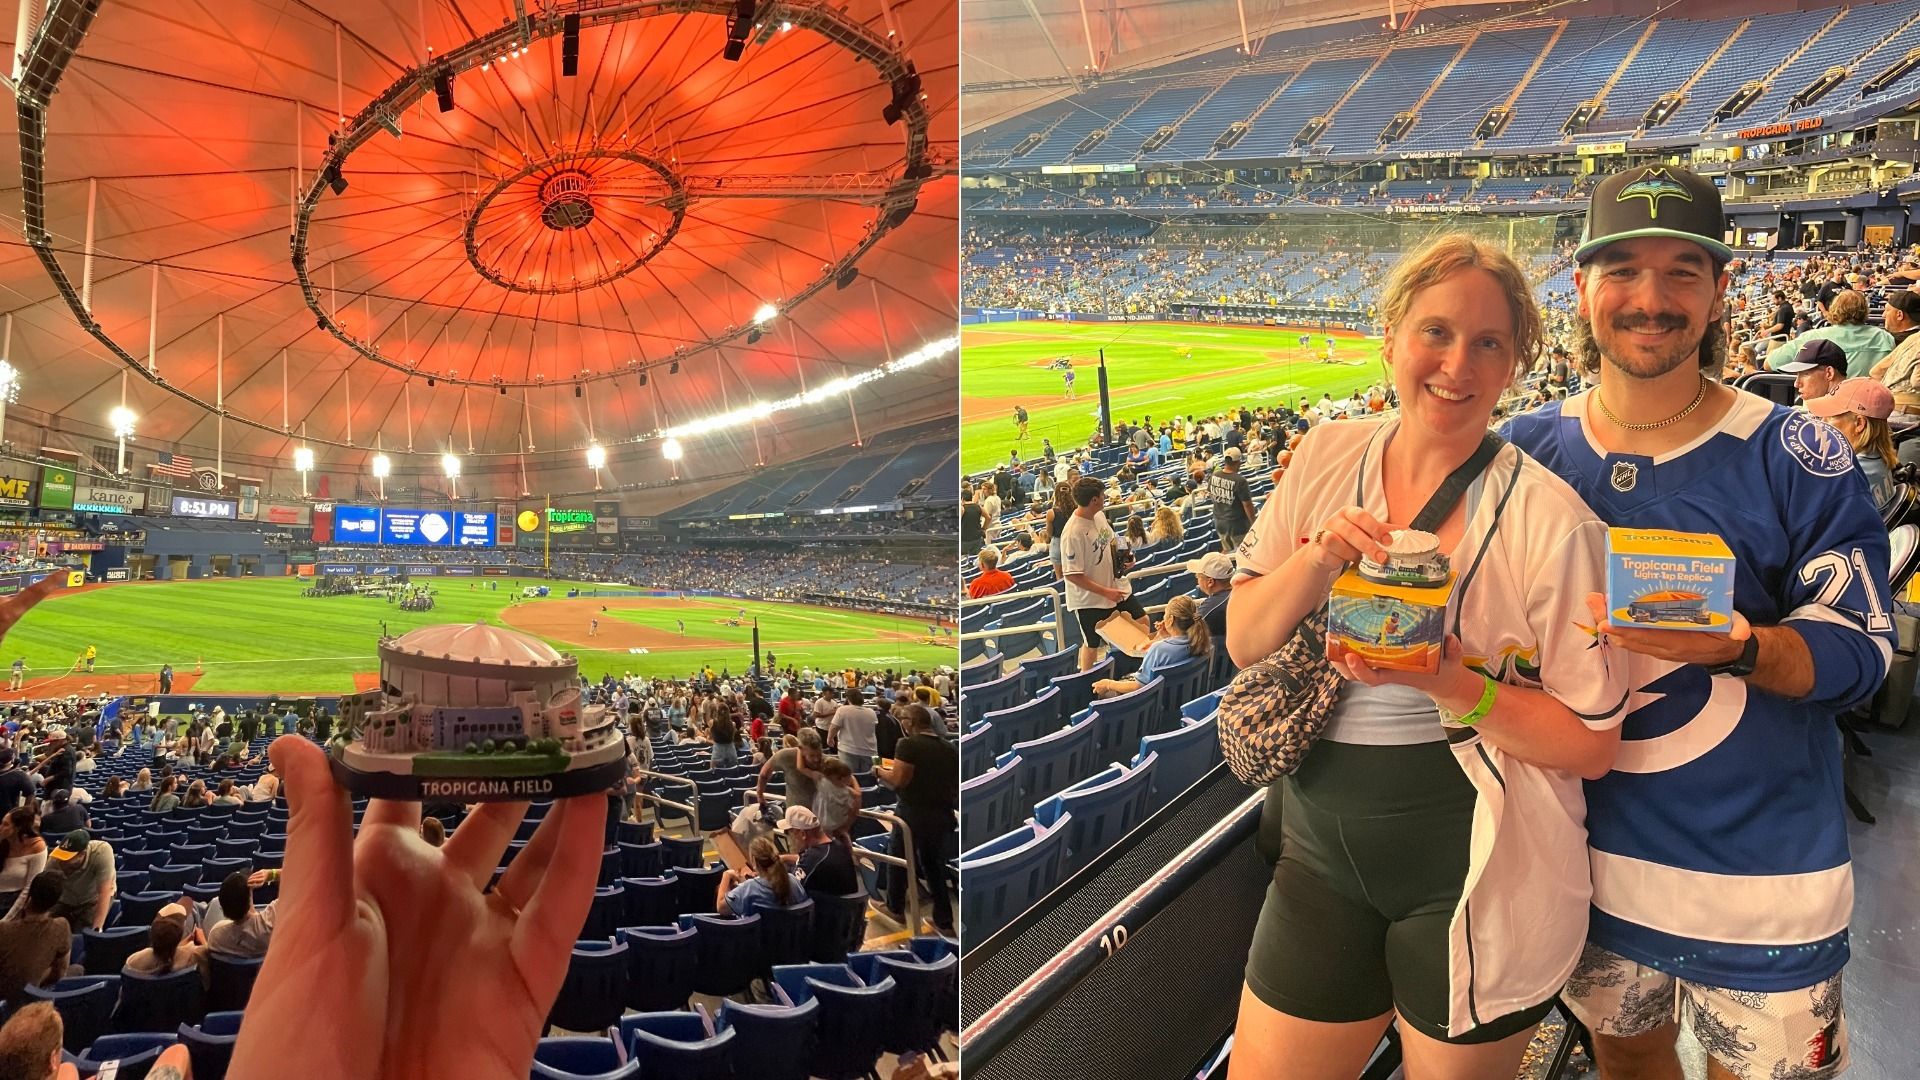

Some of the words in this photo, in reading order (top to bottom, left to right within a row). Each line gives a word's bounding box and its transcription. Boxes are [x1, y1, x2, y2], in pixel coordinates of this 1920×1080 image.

[1739, 122, 1792, 139] TROPICANA
[1796, 117, 1823, 130] FIELD
[1429, 151, 1445, 159] Suite
[1446, 150, 1462, 158] Level
[1440, 205, 1462, 213] Group
[1463, 204, 1481, 212] Club
[1787, 434, 1815, 469] TAMPA
[1616, 470, 1632, 484] NHL
[180, 501, 206, 515] 8:51
[209, 502, 229, 516] PM
[545, 508, 594, 523] Tropicana
[1622, 534, 1714, 546] Tropicana
[1621, 557, 1687, 573] Tropicana
[1691, 560, 1724, 574] Field
[1677, 571, 1713, 583] Replica
[1799, 548, 1892, 632] 21
[421, 781, 510, 796] TROPICANA
[513, 779, 553, 794] FIELD
[1100, 925, 1128, 957] 10
